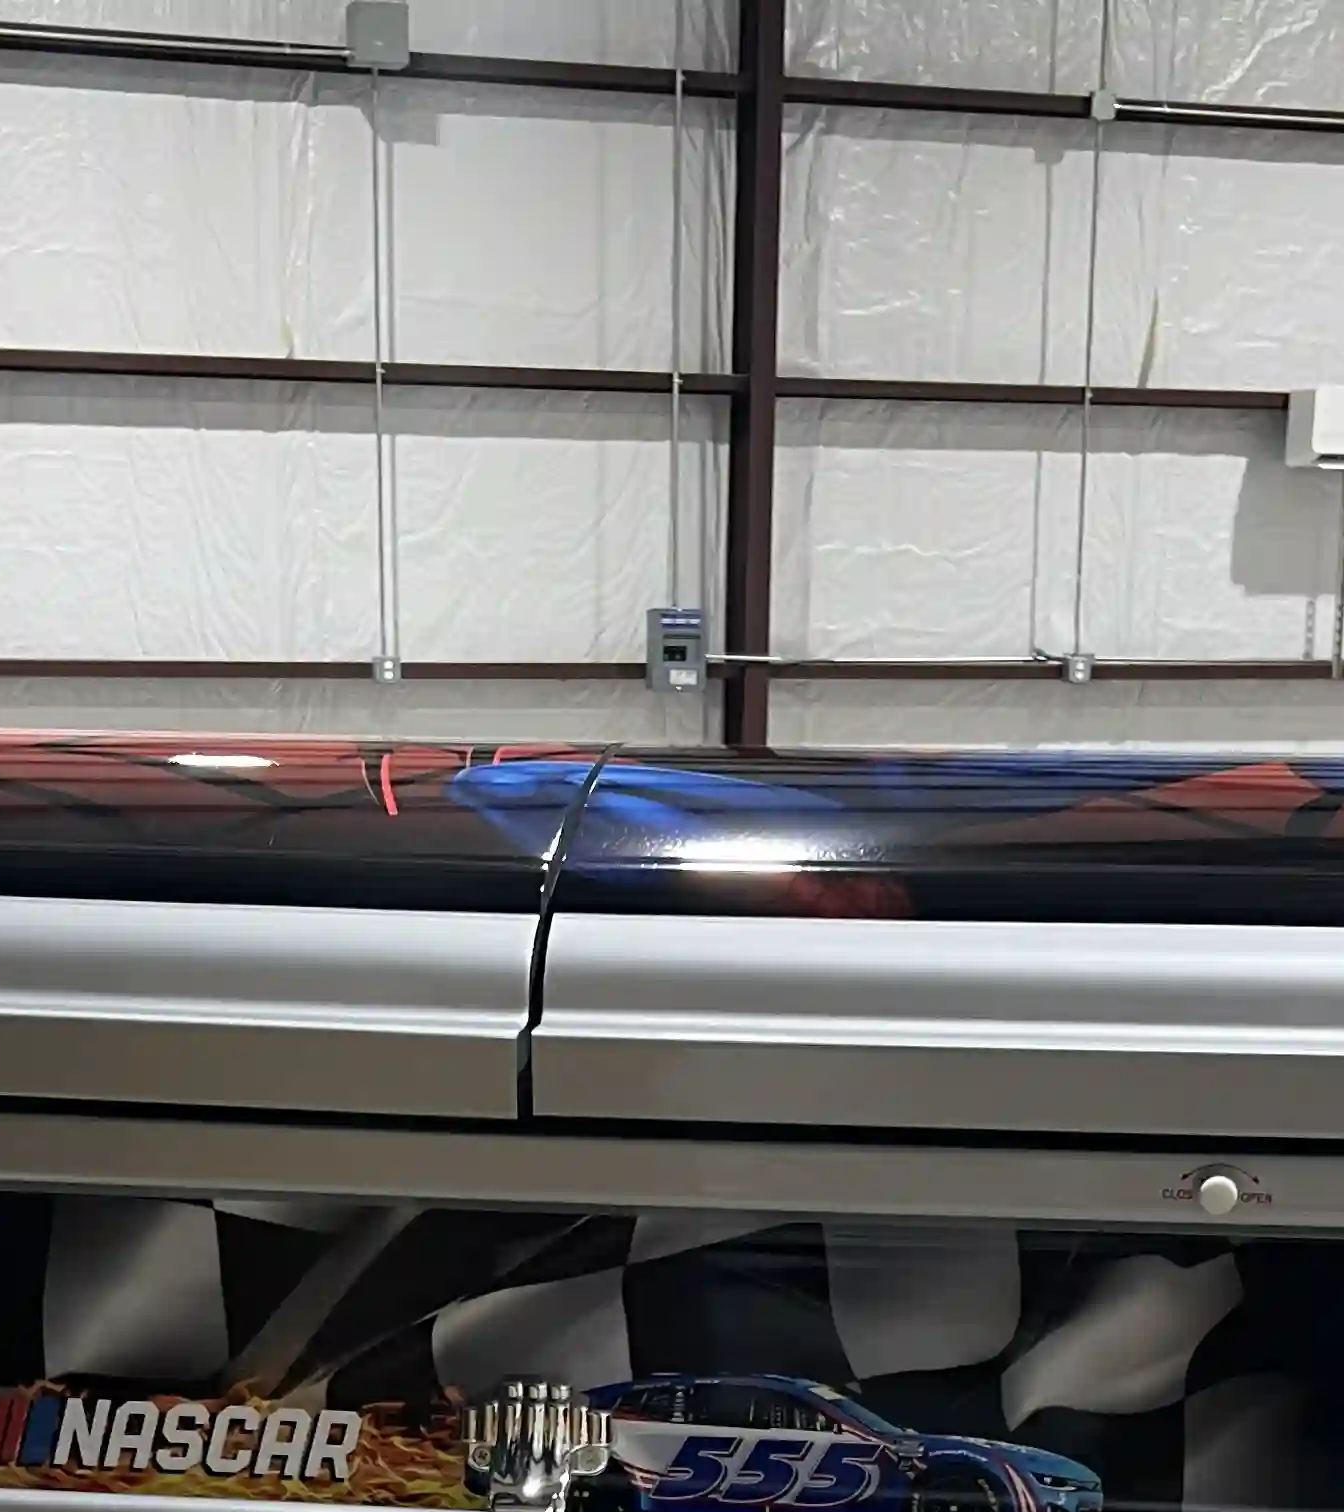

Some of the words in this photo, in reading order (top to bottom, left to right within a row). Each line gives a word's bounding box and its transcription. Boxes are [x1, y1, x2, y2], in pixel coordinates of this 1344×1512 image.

[1161, 1188, 1194, 1200] CLOS
[1240, 1191, 1273, 1205] OPEN
[54, 1397, 363, 1483] NASCAR
[650, 1435, 885, 1507] 555
